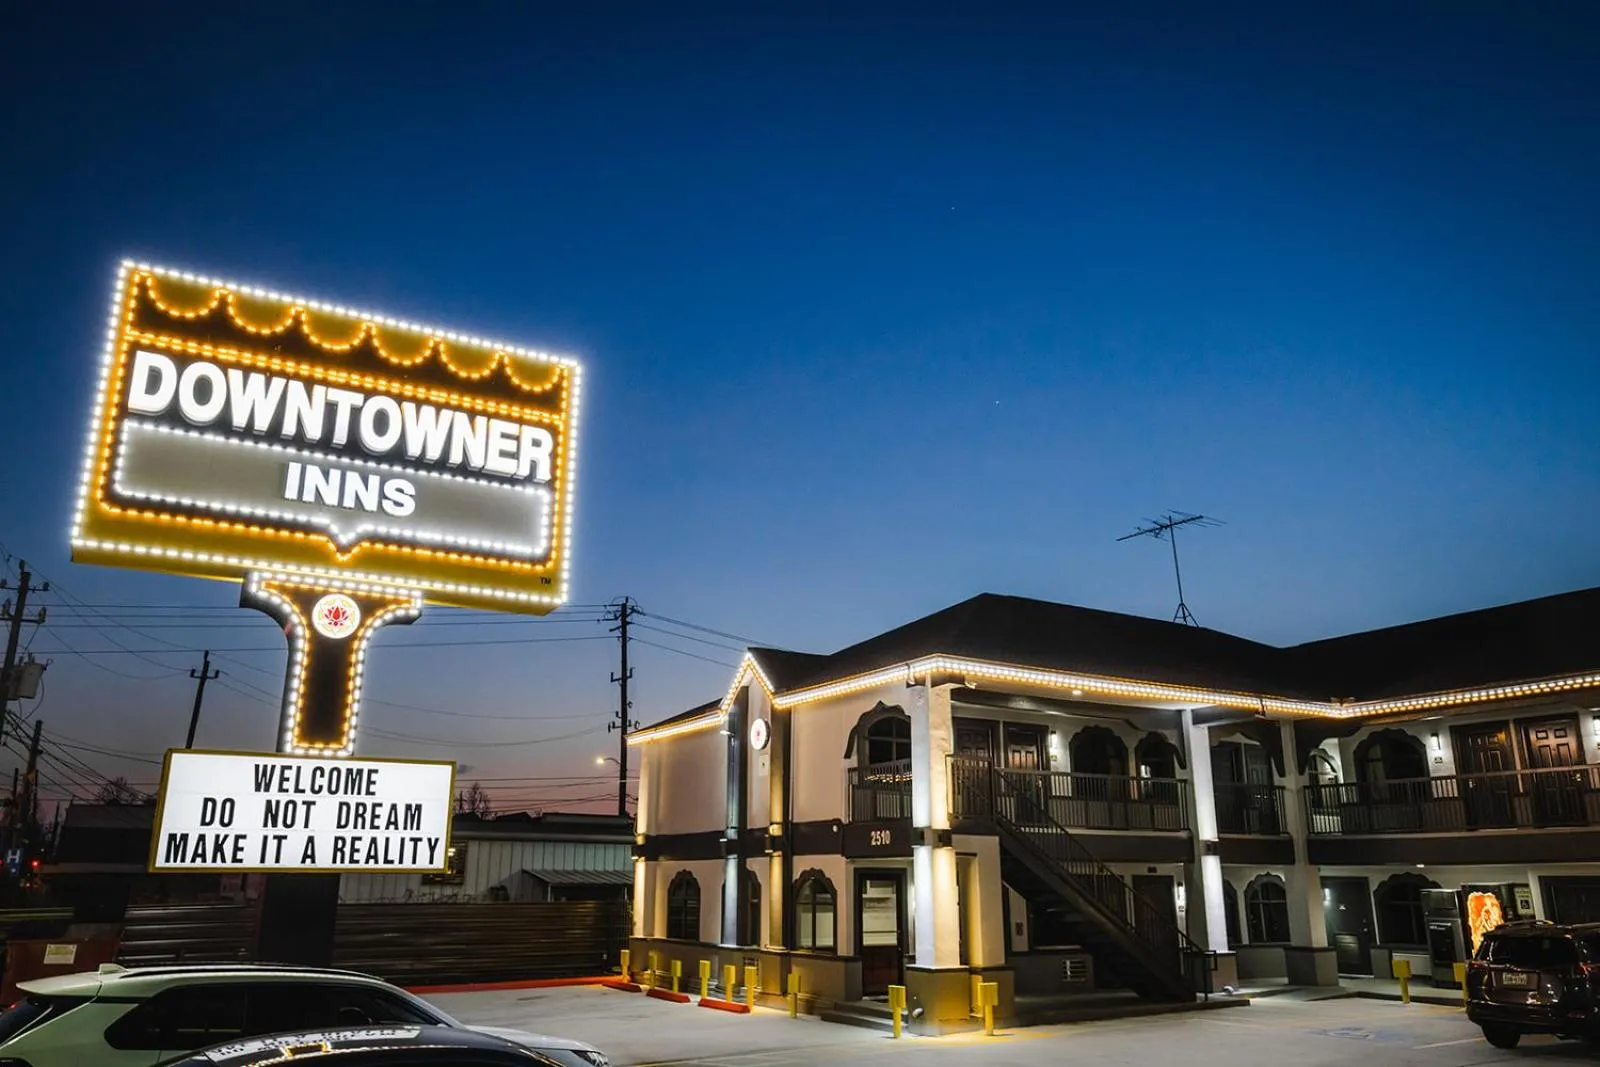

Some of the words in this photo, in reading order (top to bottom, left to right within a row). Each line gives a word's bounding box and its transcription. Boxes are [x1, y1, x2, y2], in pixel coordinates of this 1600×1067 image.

[128, 350, 554, 483] DOWNTOWNER
[284, 461, 417, 517] INNS
[254, 763, 379, 796] WELCOME
[200, 797, 236, 828] DO
[262, 799, 316, 829] NOT
[336, 801, 423, 831] DREAM
[164, 833, 247, 864] MAKE
[259, 834, 288, 864] IT
[300, 835, 317, 864] A
[331, 836, 440, 865] REALITY
[871, 830, 891, 846] 2510
[7, 849, 20, 863] H
